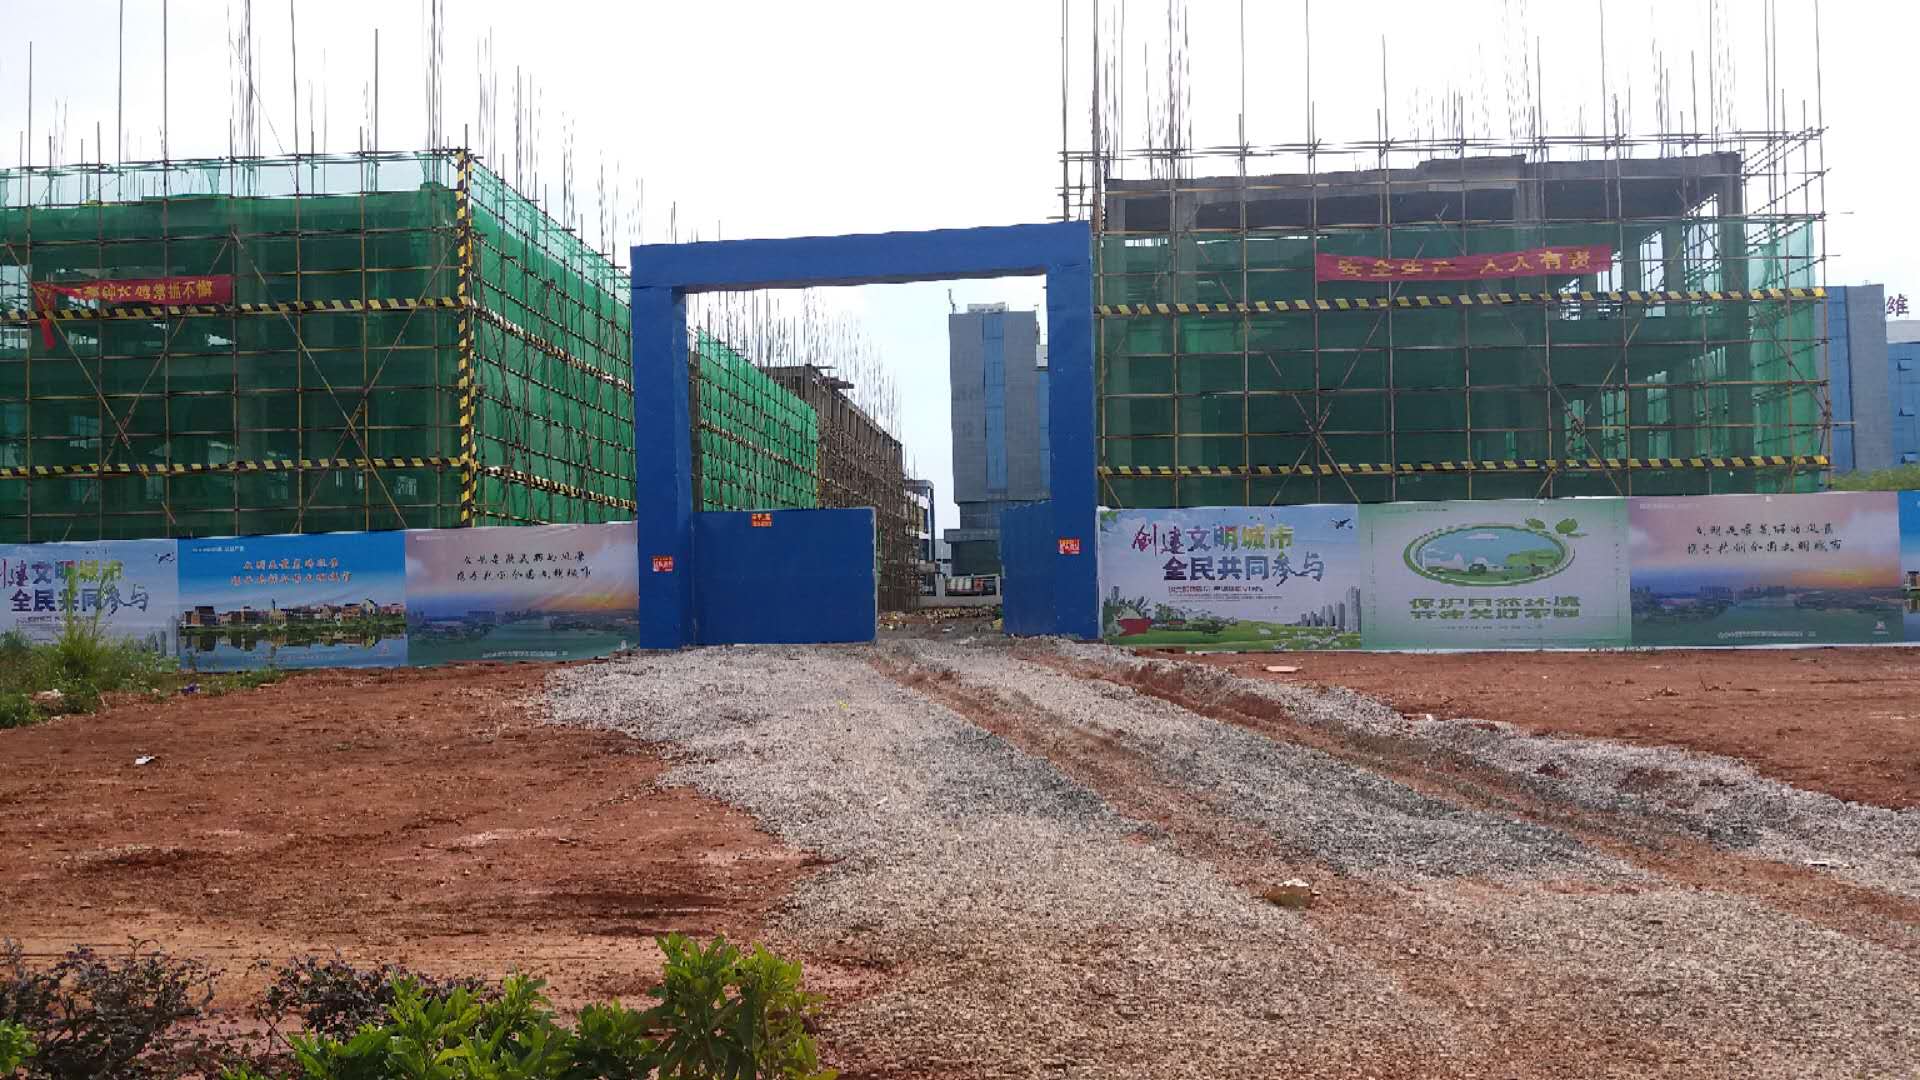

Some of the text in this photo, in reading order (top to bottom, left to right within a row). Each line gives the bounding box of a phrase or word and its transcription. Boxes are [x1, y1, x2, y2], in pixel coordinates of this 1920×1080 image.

[1886, 293, 1910, 317] 维
[1131, 523, 1295, 557] 创建文明城市
[1162, 551, 1325, 587] 全民共同参与
[10, 583, 149, 616] 全民共同参与
[1408, 596, 1581, 610] 保护自然环境
